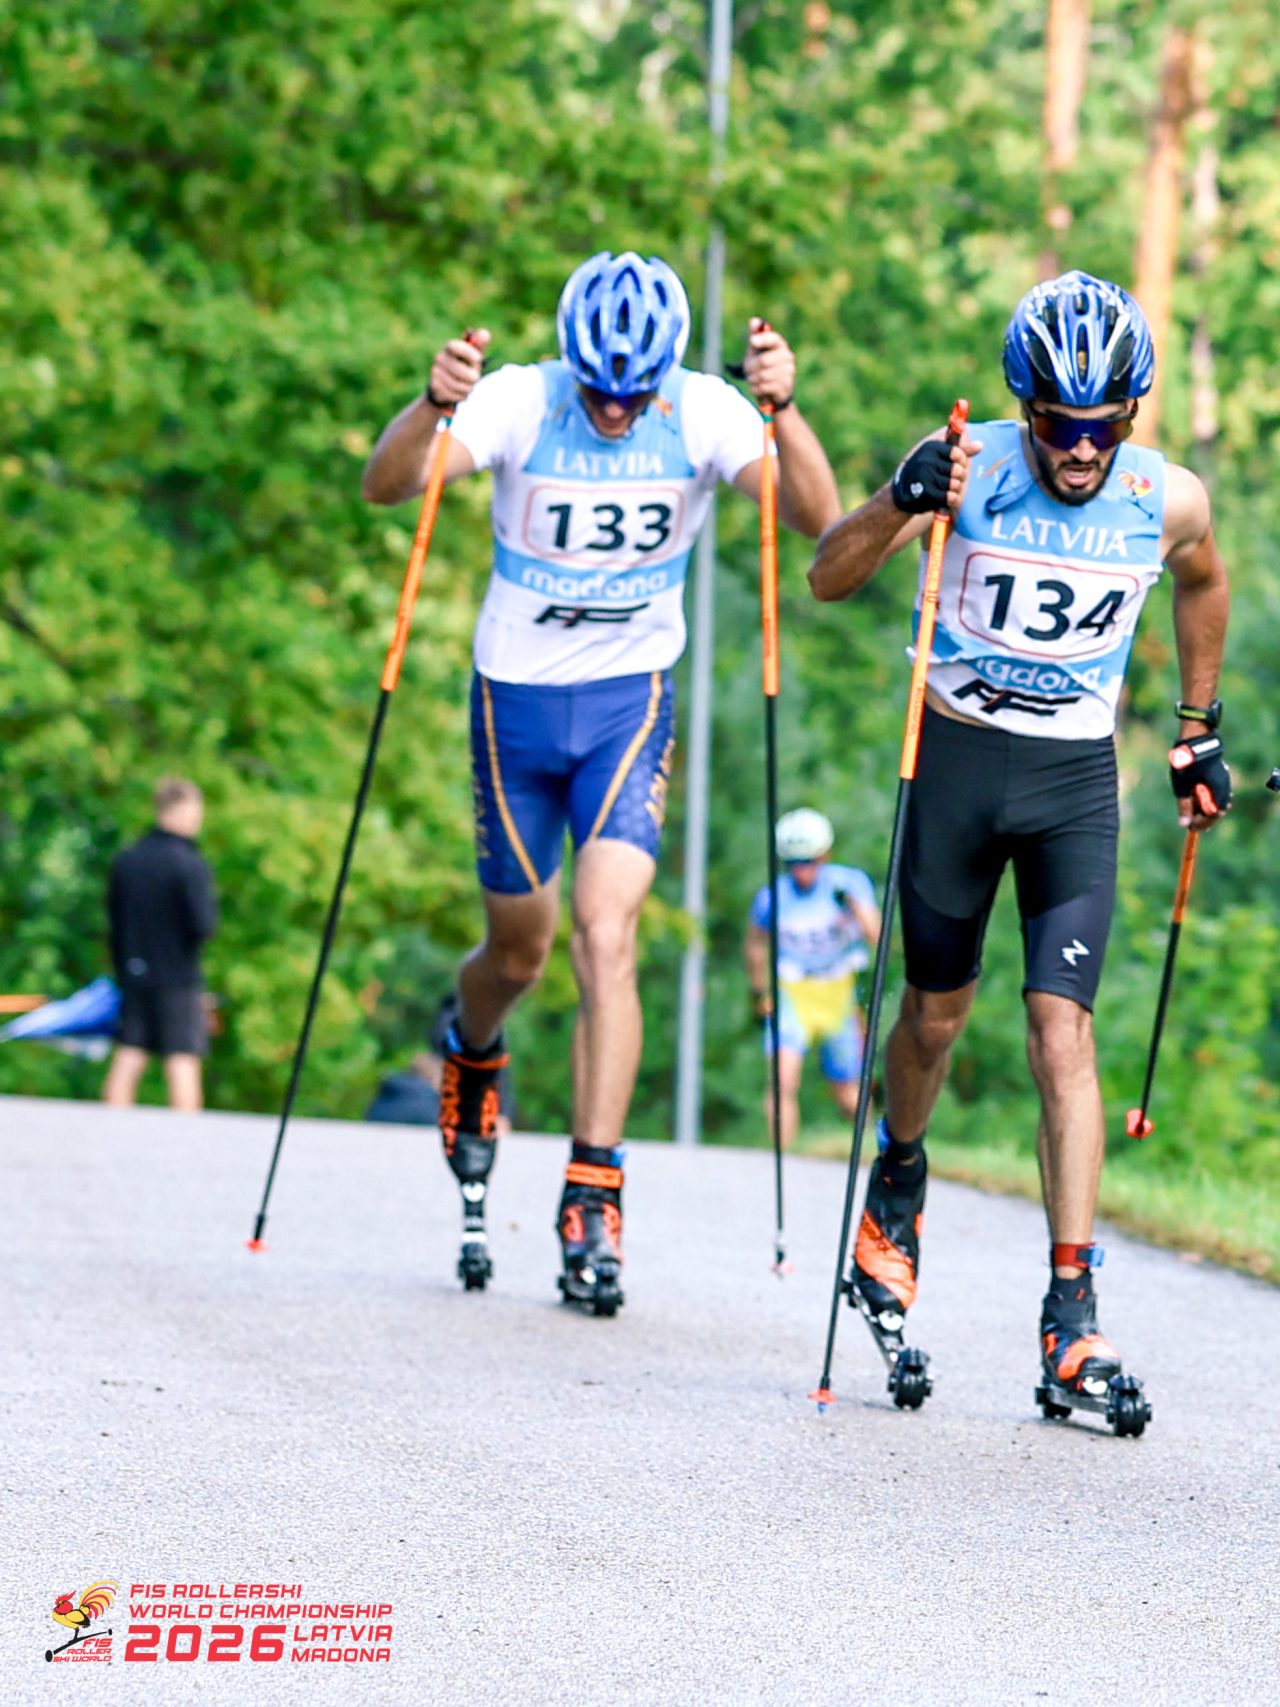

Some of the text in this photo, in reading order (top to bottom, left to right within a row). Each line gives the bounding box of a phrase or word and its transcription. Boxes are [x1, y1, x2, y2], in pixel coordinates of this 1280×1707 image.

[554, 448, 664, 477] LATVIJA
[547, 503, 671, 551] 133
[991, 514, 1128, 557] LATVIJA
[522, 567, 668, 599] madona
[984, 573, 1126, 641] 134
